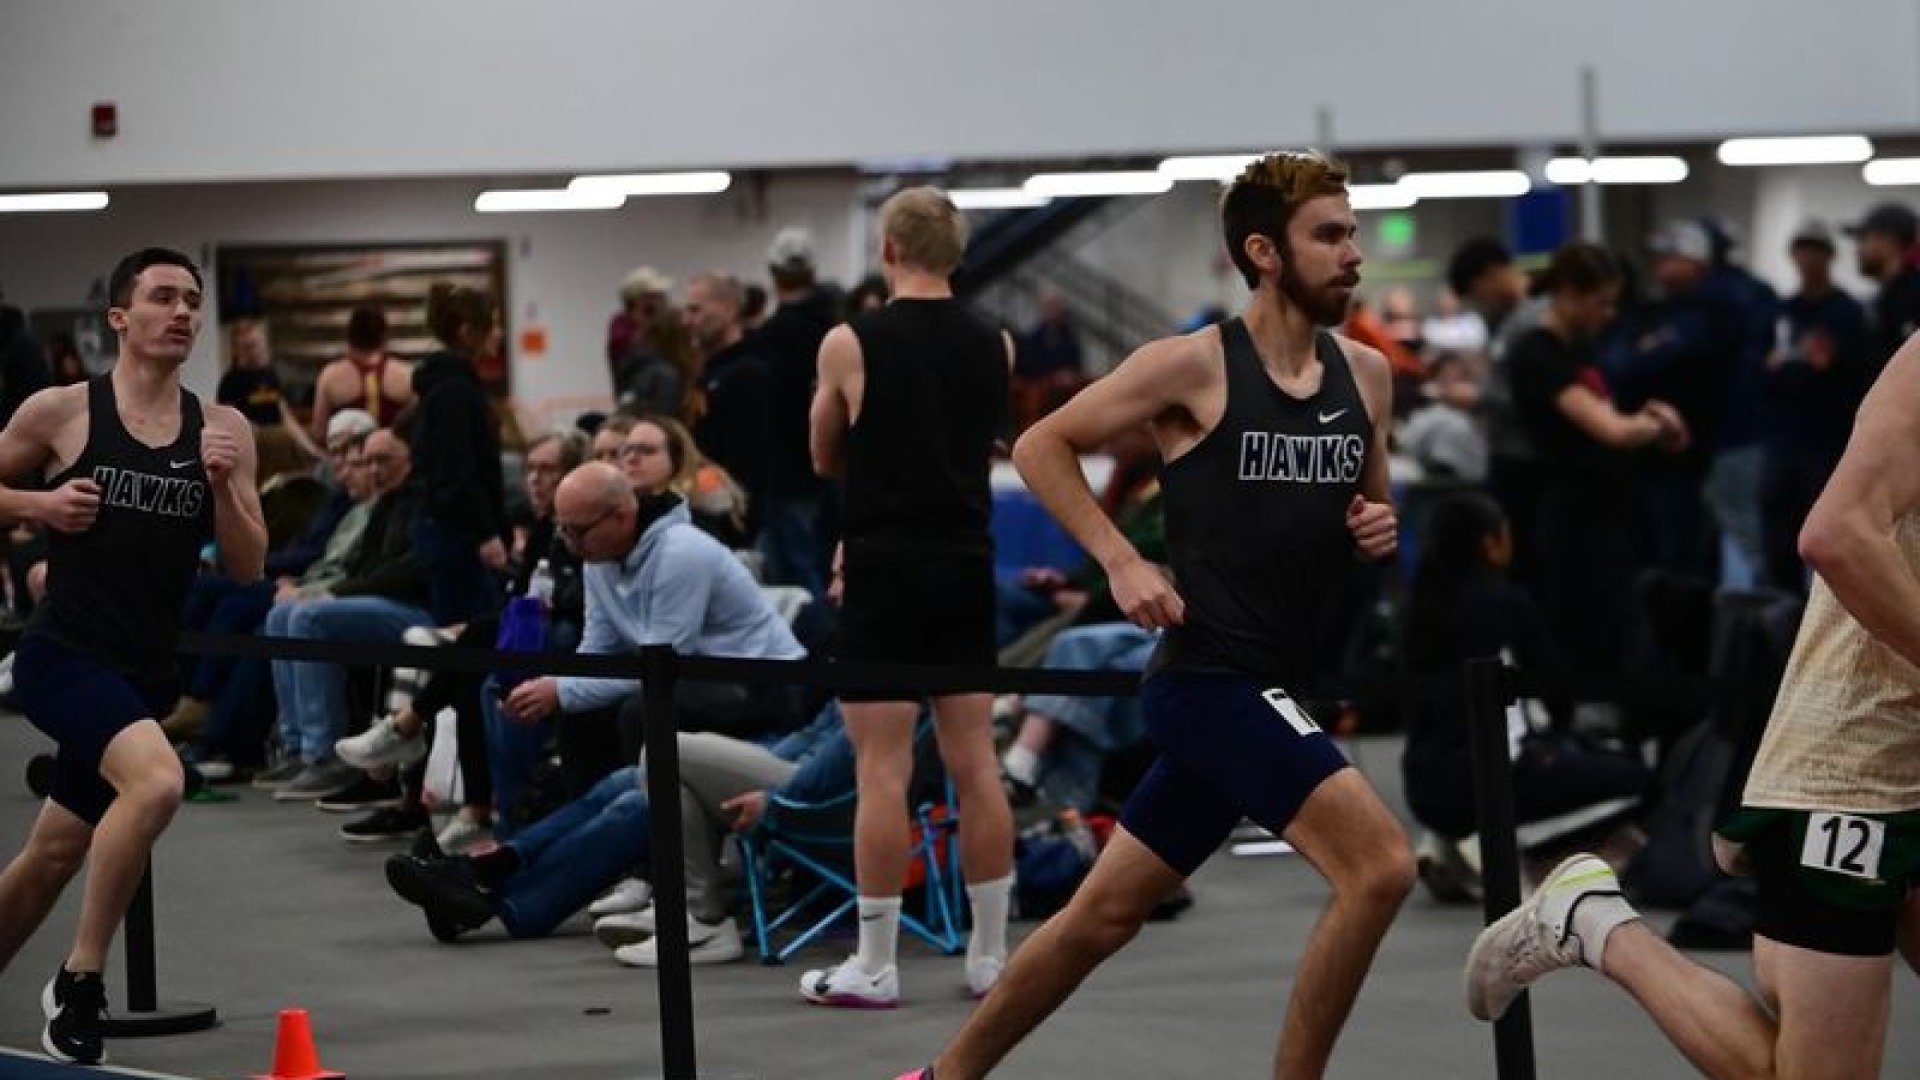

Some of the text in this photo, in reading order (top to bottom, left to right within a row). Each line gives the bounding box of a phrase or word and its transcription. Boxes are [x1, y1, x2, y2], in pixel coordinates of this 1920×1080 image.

[1239, 431, 1363, 482] HAWKS
[94, 465, 204, 516] HAWKS
[1822, 815, 1870, 873] 12
